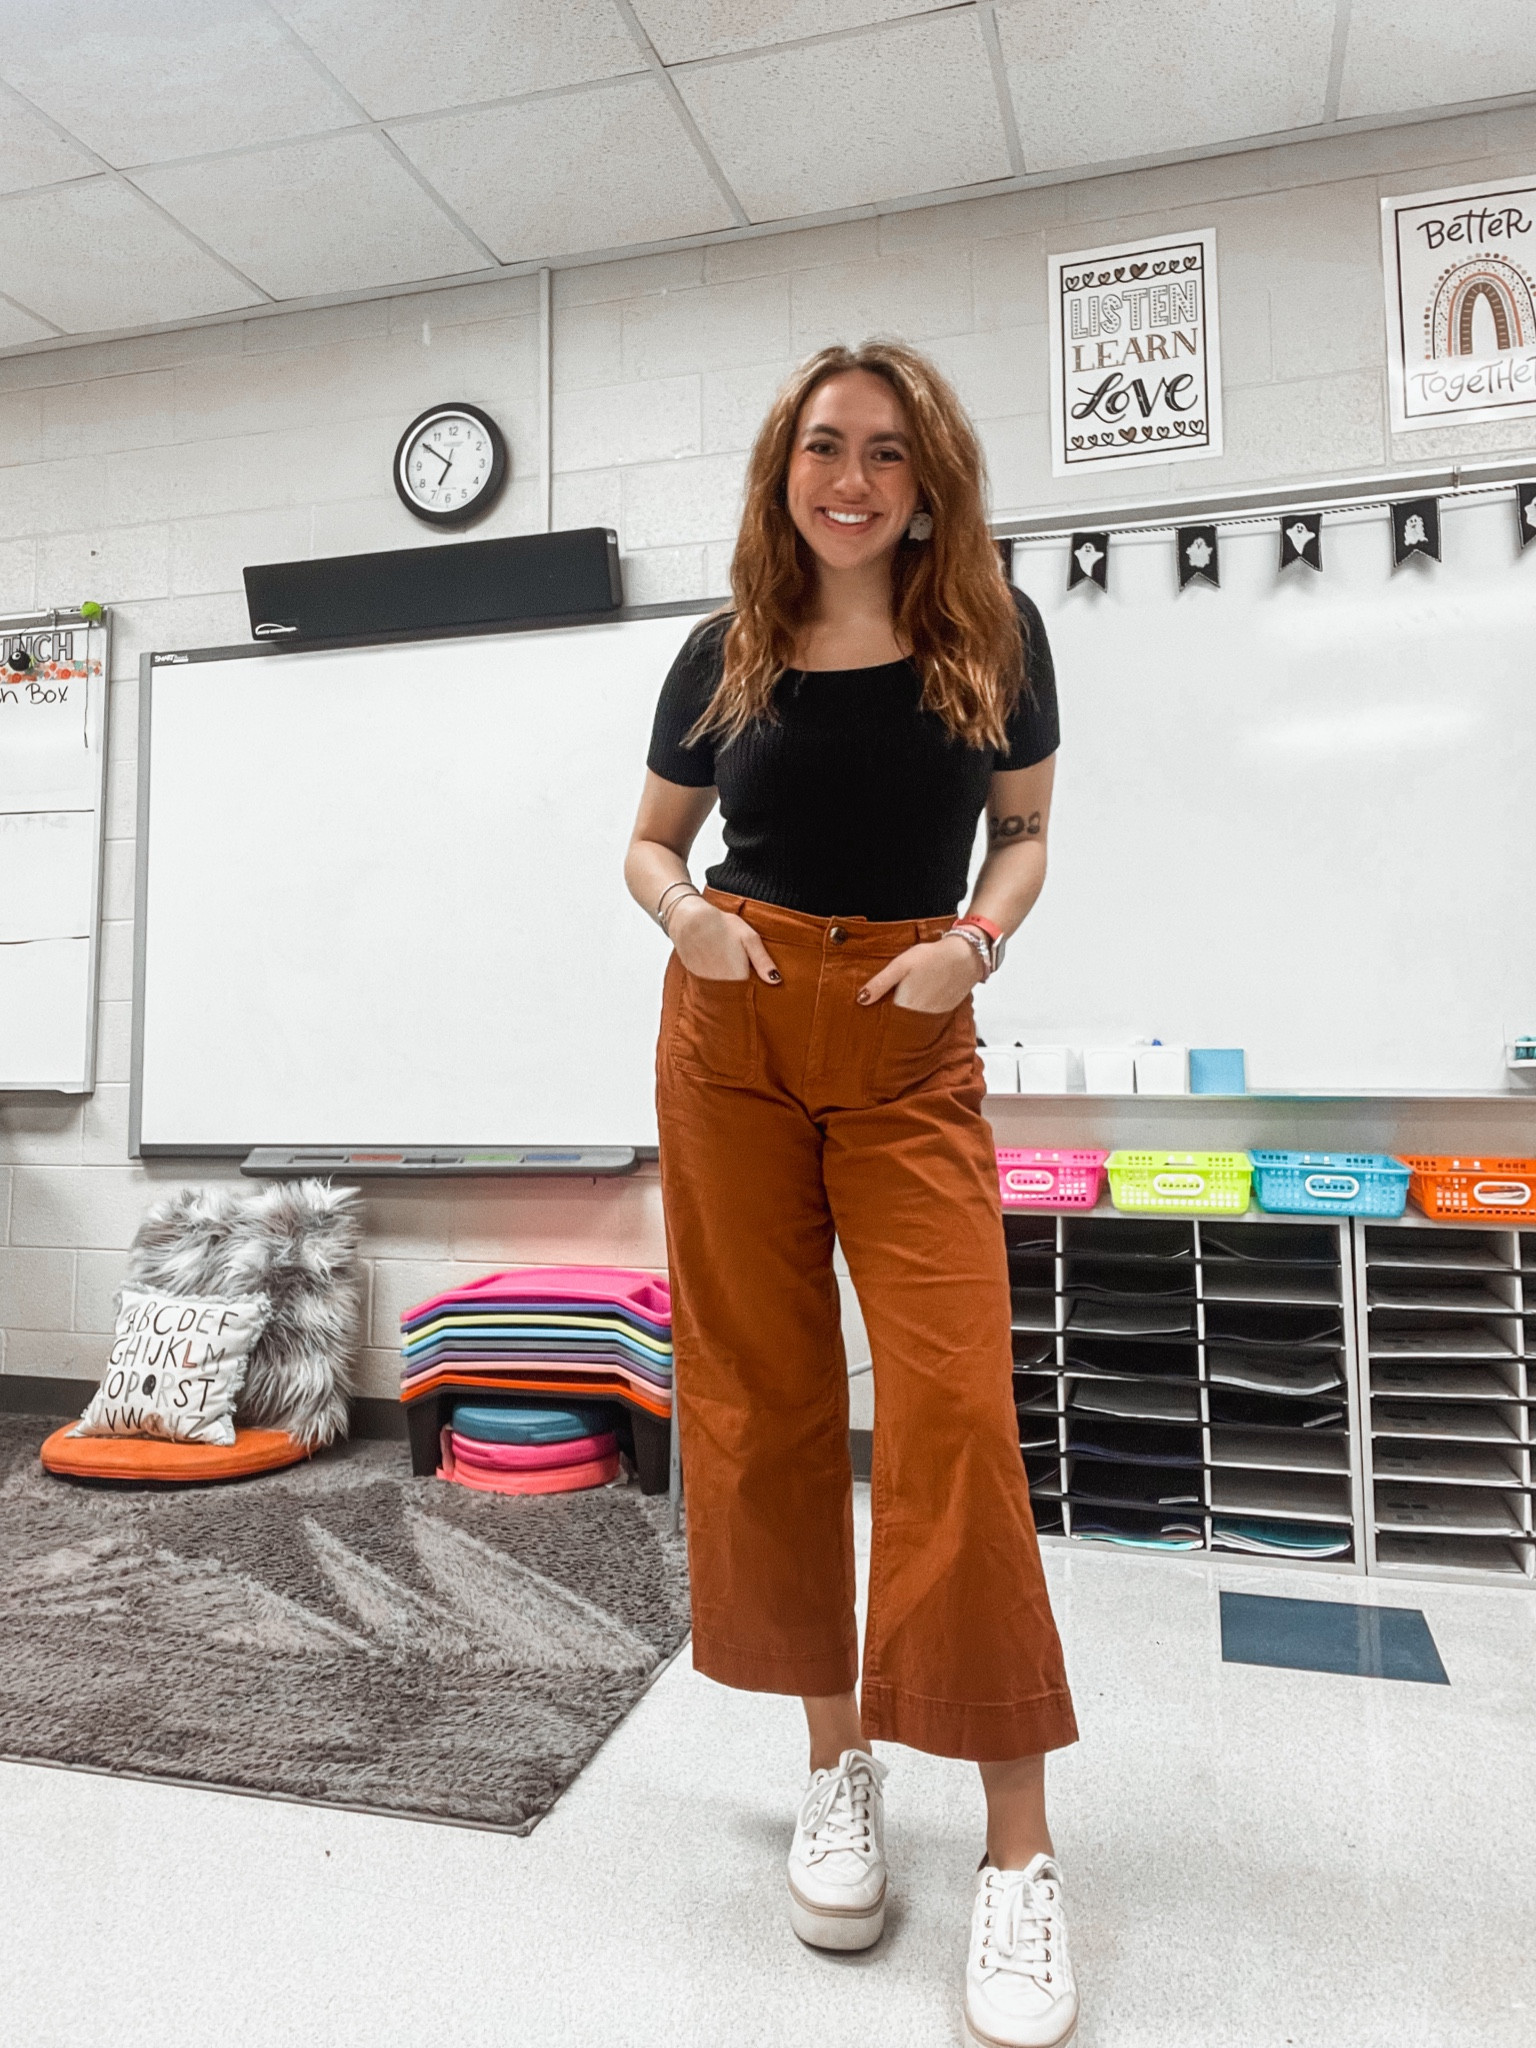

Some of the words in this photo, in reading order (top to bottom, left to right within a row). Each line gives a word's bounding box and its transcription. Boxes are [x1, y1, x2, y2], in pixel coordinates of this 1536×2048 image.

[1070, 280, 1198, 340] LISTEN
[1071, 327, 1199, 373] LEARN
[1410, 355, 1536, 402] TogeTHe
[433, 432, 442, 442] 11
[448, 426, 459, 437] 12
[475, 441, 483, 452] 2
[416, 460, 423, 472] 9
[479, 458, 486, 469] 3
[419, 478, 426, 489] 8
[431, 489, 438, 500] 7
[444, 493, 452, 504] 6
[461, 488, 468, 499] 5
[25, 683, 69, 705] Box
